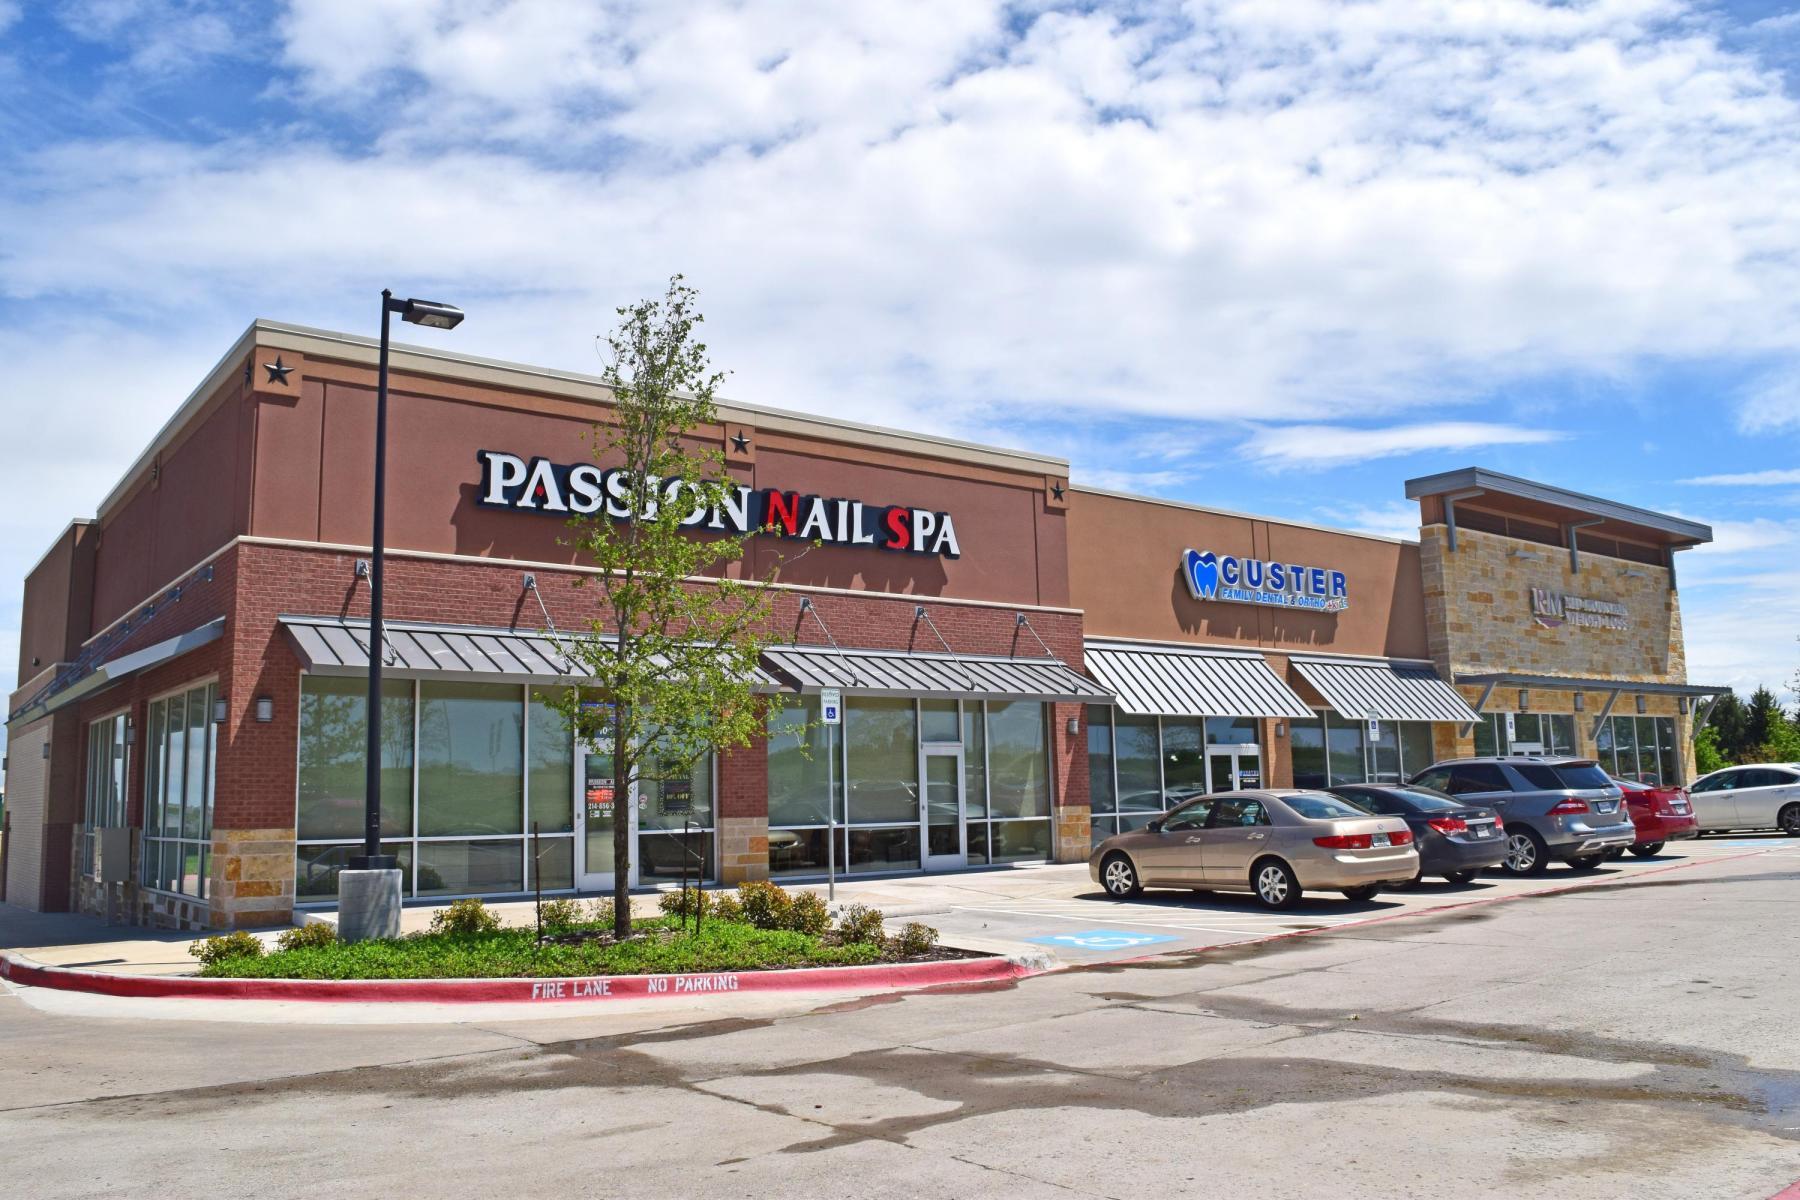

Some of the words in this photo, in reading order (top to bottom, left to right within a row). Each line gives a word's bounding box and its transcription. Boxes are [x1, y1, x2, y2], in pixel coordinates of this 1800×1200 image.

[483, 452, 752, 531] PASSION
[764, 490, 874, 544] NAIL
[886, 506, 960, 555] SPA
[1220, 555, 1347, 597] CUSTER
[1222, 588, 1253, 601] FAMILY
[1256, 591, 1288, 605] DENTAL
[1298, 596, 1325, 608] ORTHO
[531, 982, 566, 999] FIRE
[574, 980, 613, 997] LANE
[648, 978, 668, 993] NO
[675, 975, 739, 993] PARKING
